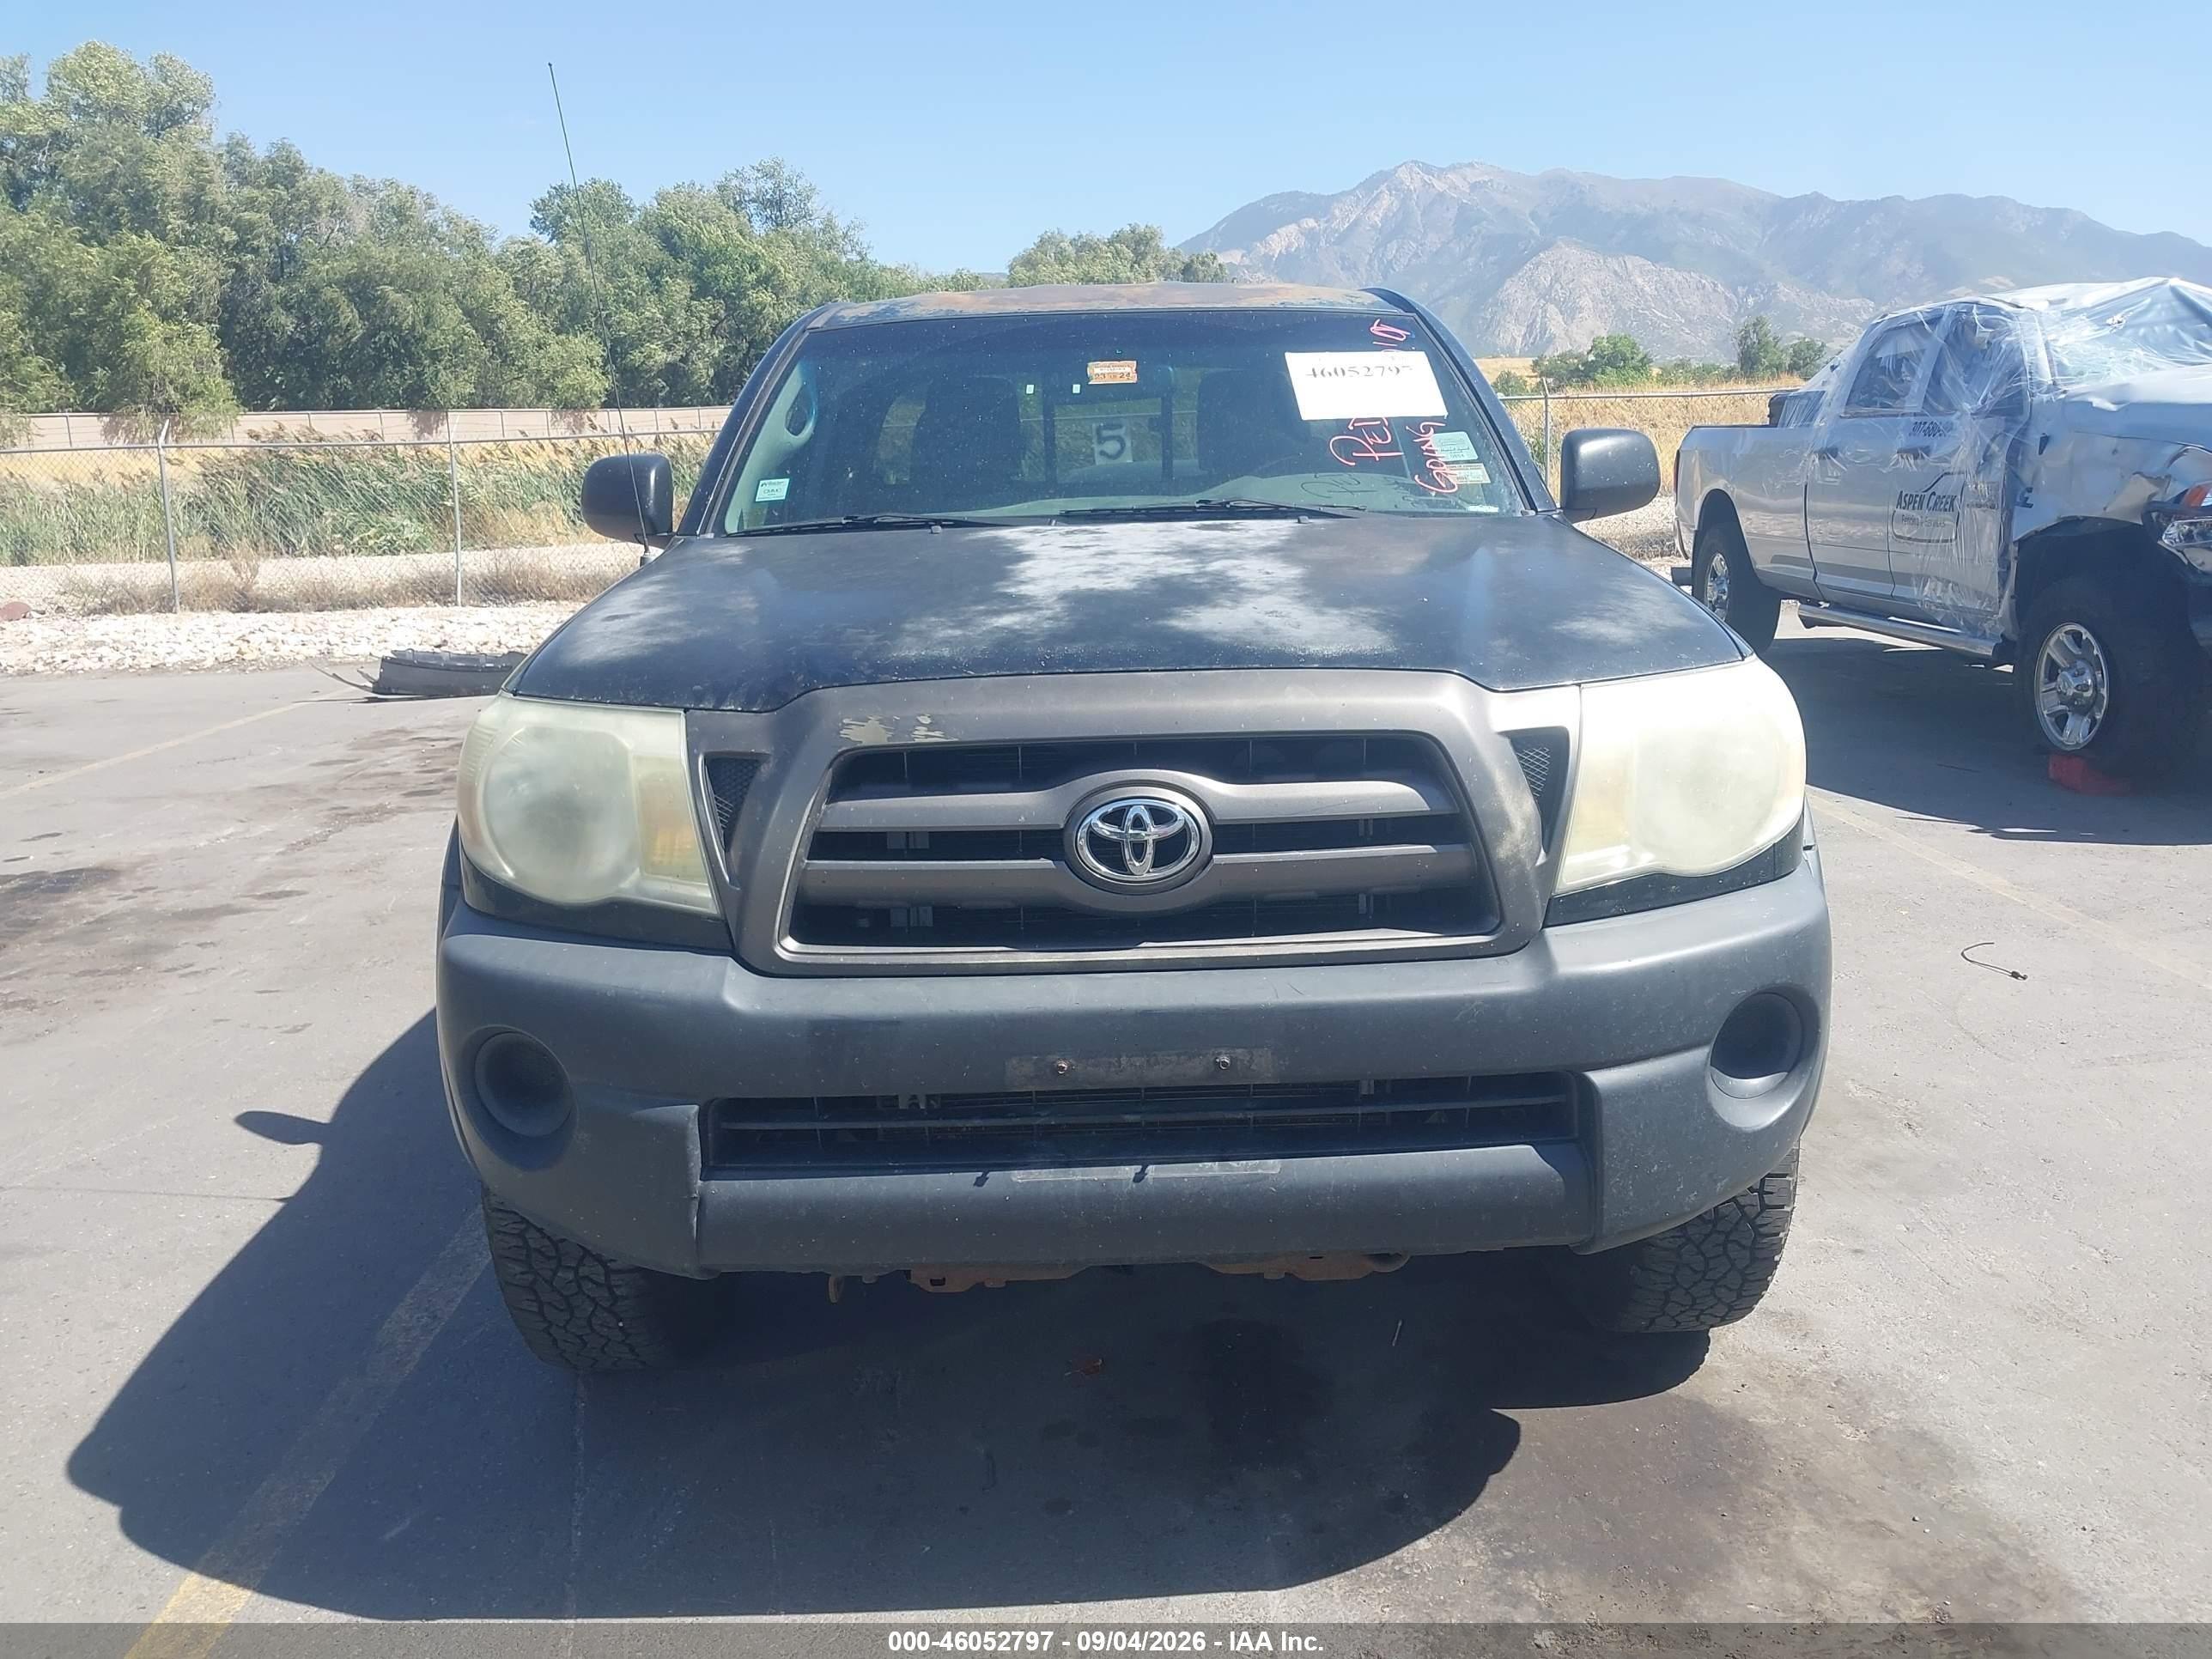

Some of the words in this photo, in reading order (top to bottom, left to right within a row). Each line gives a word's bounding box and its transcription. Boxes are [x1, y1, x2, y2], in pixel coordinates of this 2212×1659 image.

[1097, 423, 1126, 459] 5
[1908, 420, 1951, 438] 307-680-
[1406, 422, 1458, 494] GOING
[1896, 490, 1925, 510] ASPEN
[1926, 491, 1957, 513] CREEK
